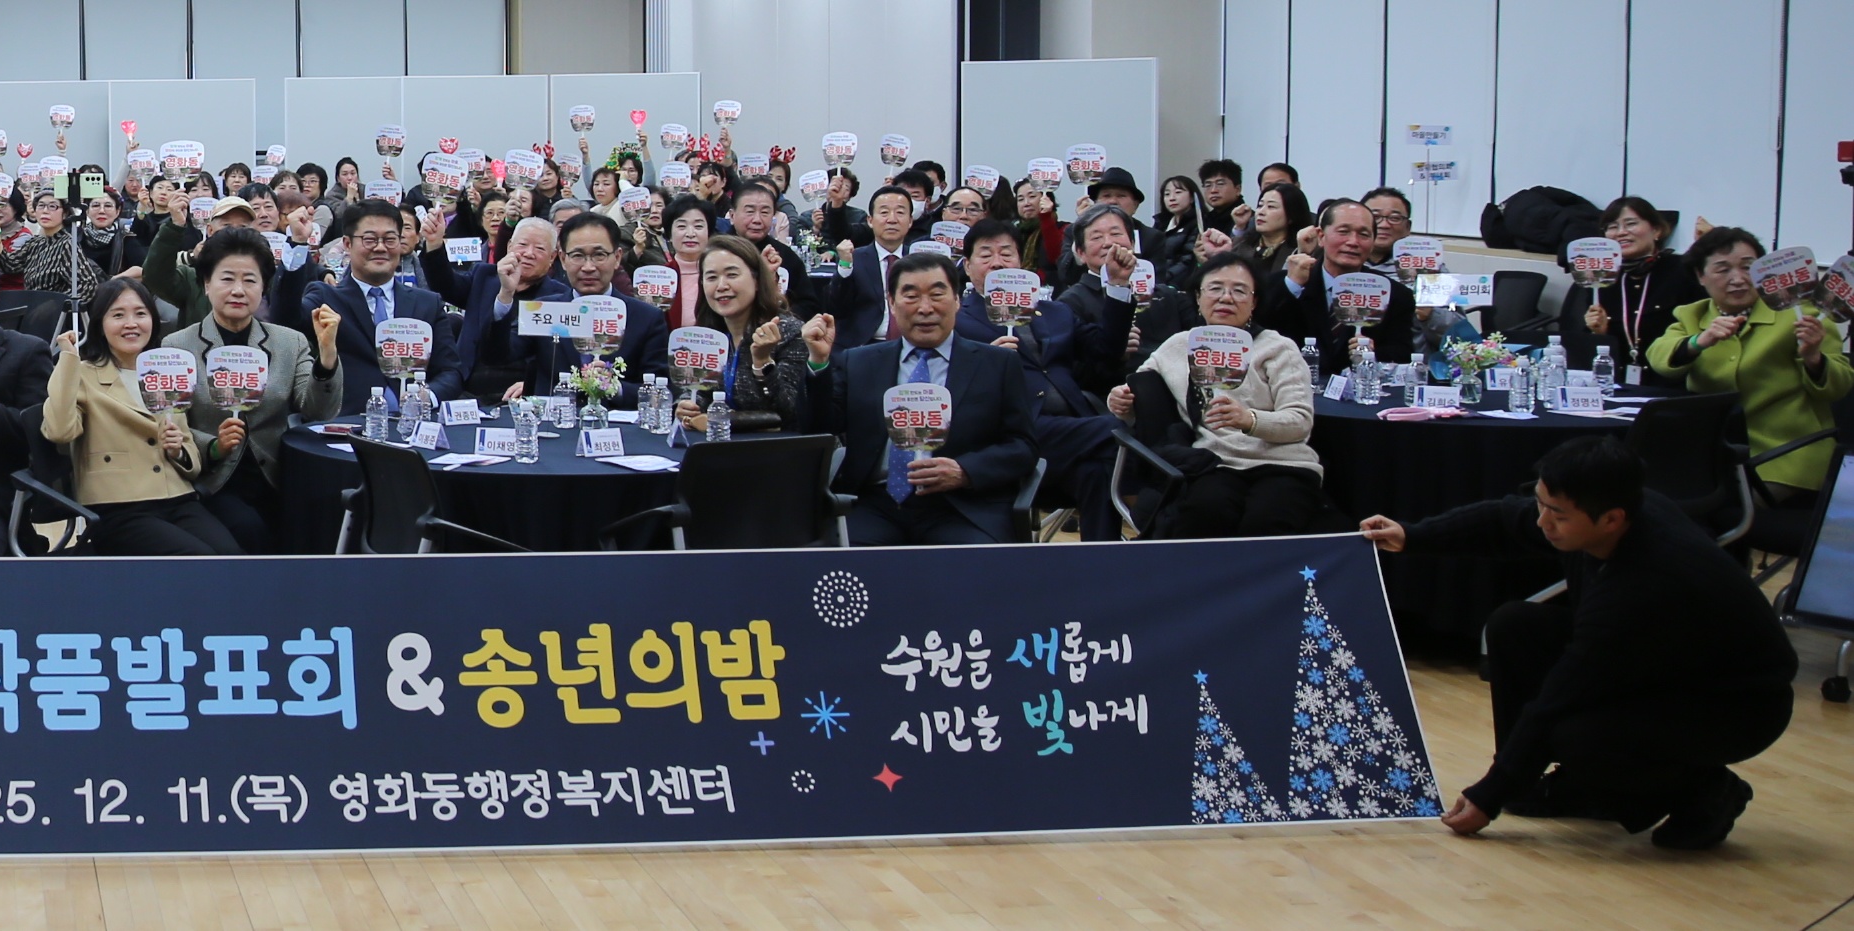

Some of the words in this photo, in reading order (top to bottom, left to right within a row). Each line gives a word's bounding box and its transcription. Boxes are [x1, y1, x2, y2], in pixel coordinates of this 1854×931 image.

[165, 157, 198, 168] 영화동
[508, 163, 536, 177] 영화동
[1070, 160, 1100, 171] 영화동
[426, 170, 460, 187] 영화동
[1399, 255, 1436, 269] 영화동
[1574, 258, 1614, 271] 영화동
[1761, 267, 1810, 294] 영화동
[638, 284, 671, 296] 영화동
[1460, 284, 1491, 296] 협의회
[991, 291, 1032, 306] 영화동
[1339, 292, 1381, 308] 영화동
[531, 313, 552, 325] 주요
[560, 314, 581, 327] 내빈
[382, 342, 424, 358] 영화동
[675, 350, 719, 368] 영화동
[1195, 350, 1242, 368] 영화동
[144, 373, 189, 391] 영화동
[214, 371, 259, 389] 영화동
[892, 411, 942, 428] 영화동
[881, 630, 991, 691] 수원을
[1007, 622, 1132, 683] 새롭게
[387, 633, 444, 715] &
[459, 620, 785, 729] 송년의밤
[891, 705, 1001, 752] 시민을
[1023, 690, 1147, 755] 빛나게
[74, 778, 144, 824] 12.
[168, 775, 308, 823] 11.(목)
[330, 765, 735, 822] 영화동행정복지센터
